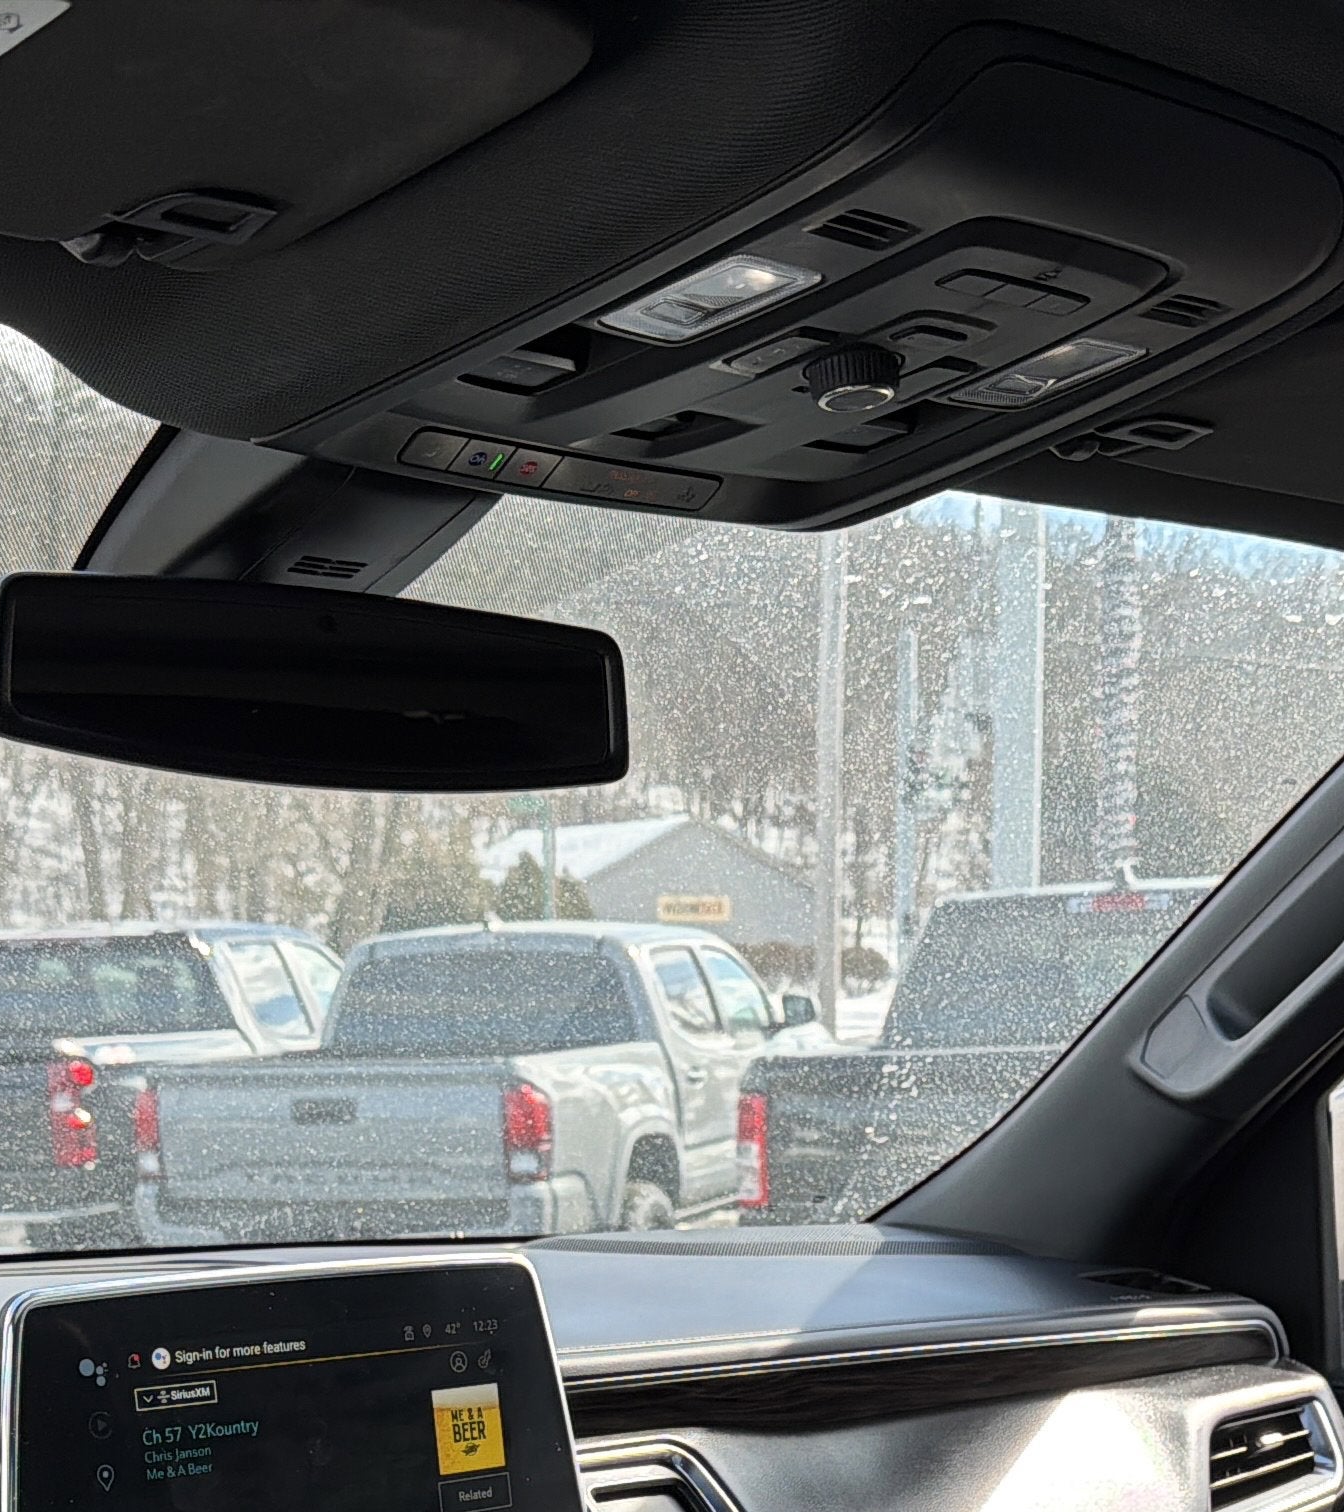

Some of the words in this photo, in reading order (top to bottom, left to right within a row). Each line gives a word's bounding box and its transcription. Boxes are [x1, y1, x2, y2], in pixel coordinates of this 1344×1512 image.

[473, 1319, 499, 1332] 12:23
[175, 1348, 213, 1365] Sign-in
[215, 1345, 231, 1359] for
[233, 1343, 261, 1358] more
[262, 1340, 306, 1355] features
[170, 1386, 211, 1401] SiriusXM
[451, 1409, 465, 1423] ME
[467, 1407, 475, 1421] &
[477, 1406, 485, 1420] A
[142, 1429, 162, 1446] Ch
[165, 1426, 182, 1443] 57
[188, 1420, 260, 1440] Y2Kountry
[452, 1420, 487, 1444] BEER
[144, 1450, 173, 1464] Chris
[175, 1447, 212, 1463] Janson
[146, 1468, 165, 1480] Me
[166, 1465, 177, 1478] &
[177, 1464, 187, 1477] A
[187, 1462, 213, 1476] Beer
[458, 1486, 493, 1502] Related
